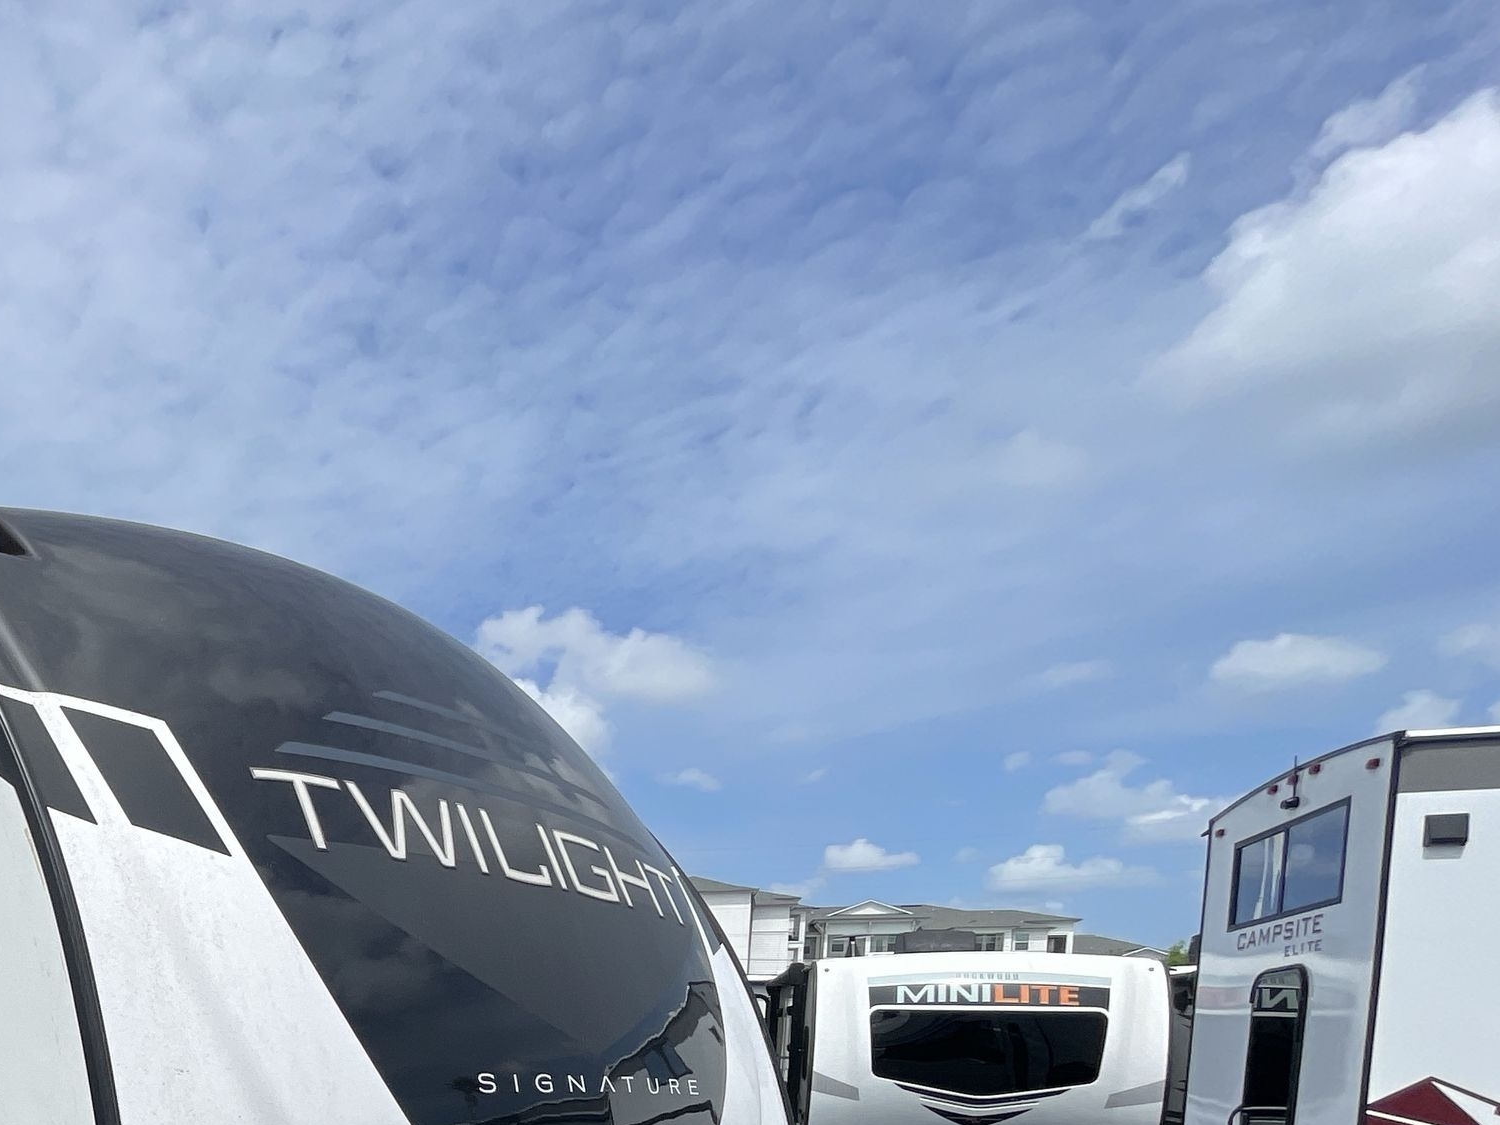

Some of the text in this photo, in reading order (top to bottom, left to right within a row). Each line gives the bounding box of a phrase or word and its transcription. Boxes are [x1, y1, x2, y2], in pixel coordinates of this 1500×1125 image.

[249, 767, 684, 925] TWILIGHT
[1237, 913, 1324, 951] CAMPSITE
[1284, 939, 1322, 957] ELITE
[896, 983, 1080, 1005] MINILITE
[477, 1072, 700, 1096] SIGNATURE
